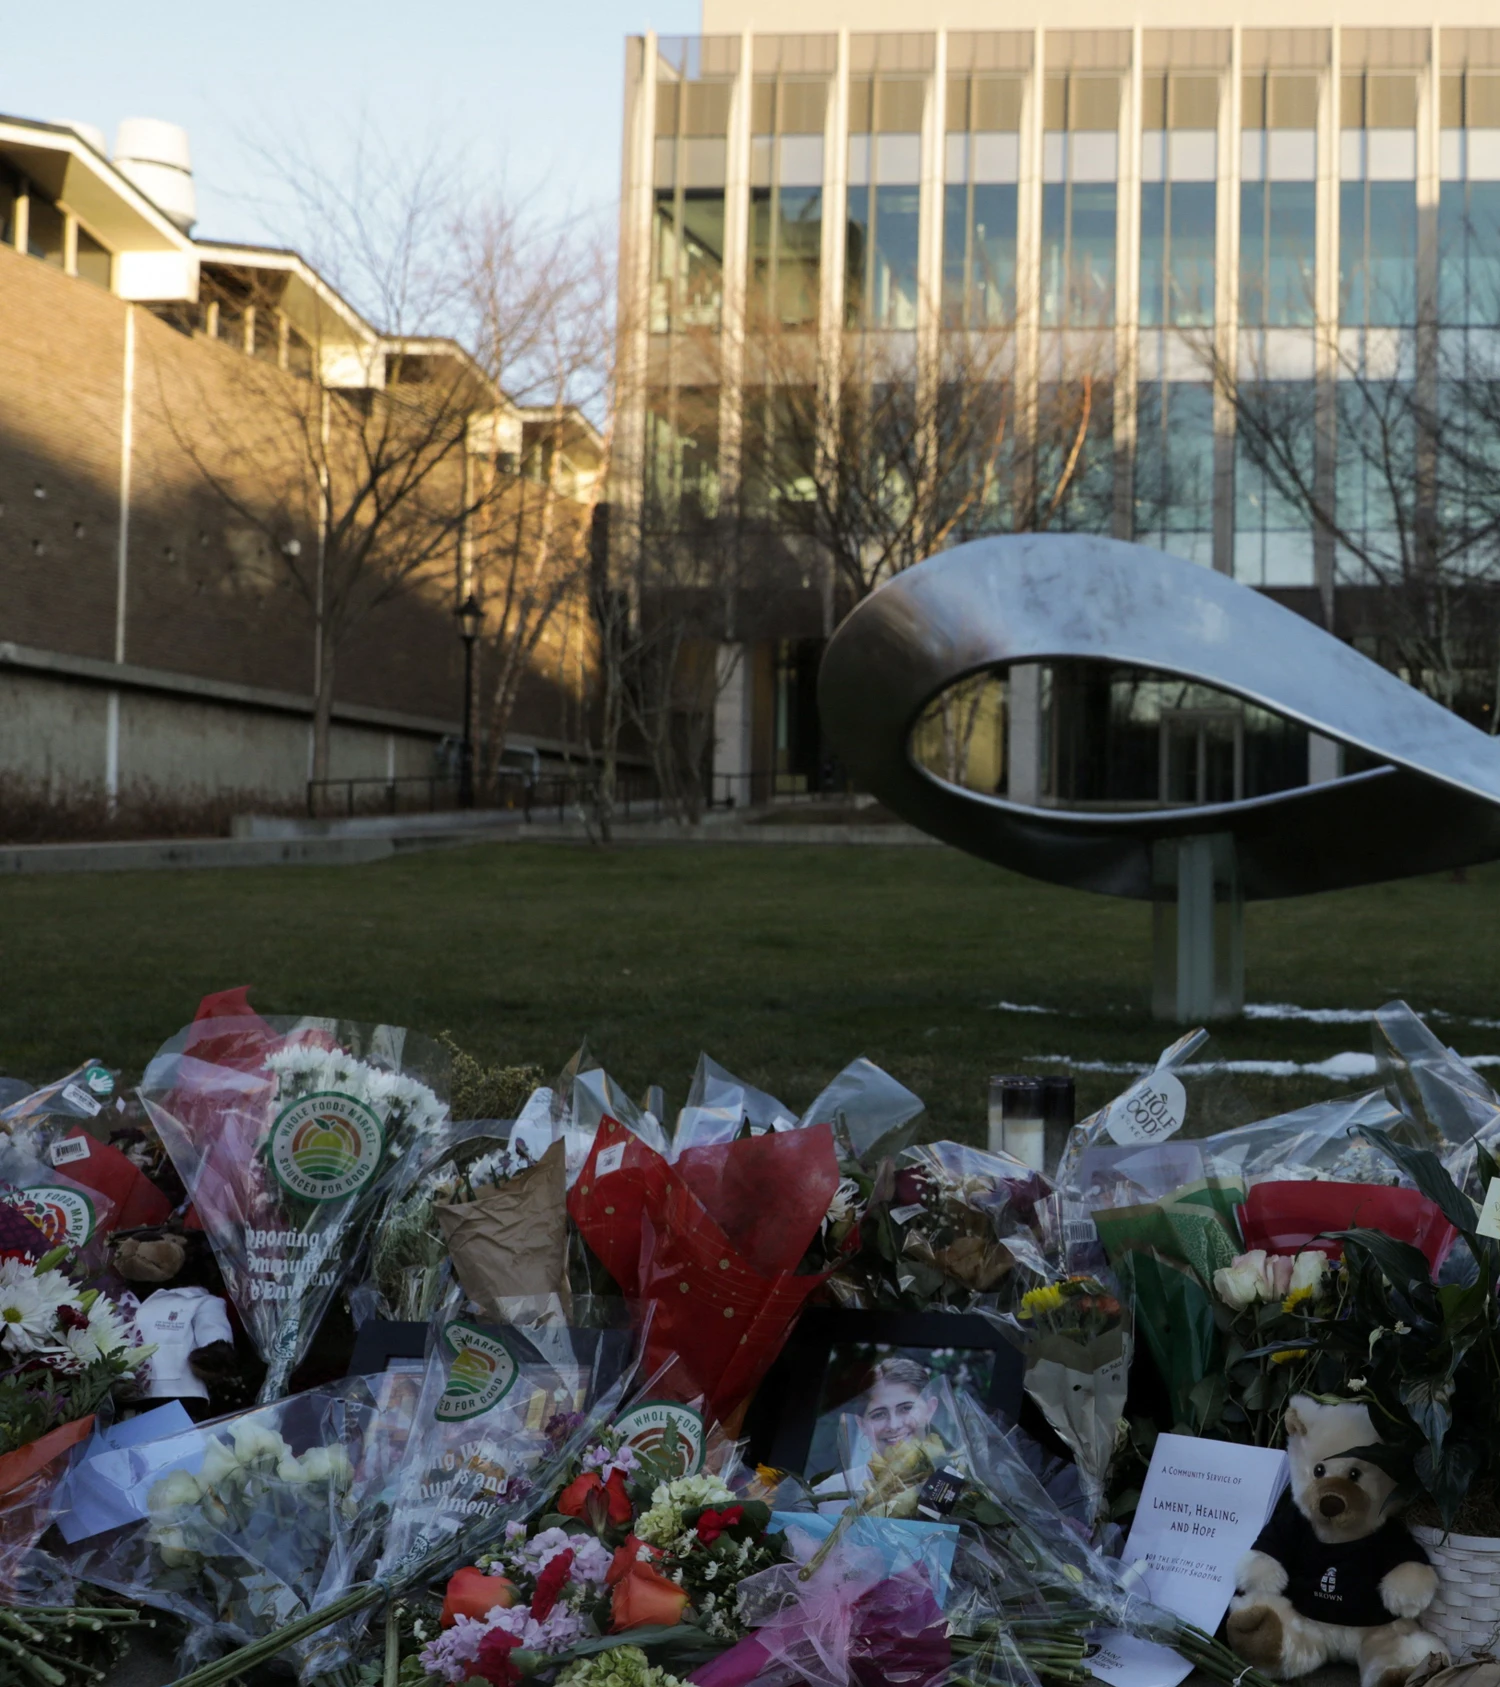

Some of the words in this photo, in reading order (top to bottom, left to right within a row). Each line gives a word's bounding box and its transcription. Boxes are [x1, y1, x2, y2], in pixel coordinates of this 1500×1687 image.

[280, 1107, 309, 1137] WHOLE
[312, 1101, 346, 1113] FOODS
[348, 1108, 377, 1144] MARKET
[280, 1157, 317, 1193] SOURCED
[321, 1184, 343, 1195] FOR
[346, 1163, 370, 1187] GOOD
[45, 1192, 77, 1207] FOODS
[465, 1334, 506, 1358] MARKET
[455, 1399, 475, 1411] FOR
[480, 1378, 503, 1404] GOOD
[1161, 1466, 1167, 1474] A
[472, 1471, 509, 1494] and
[1313, 1591, 1343, 1602] BROWN
[1102, 1649, 1121, 1660] SAINT
